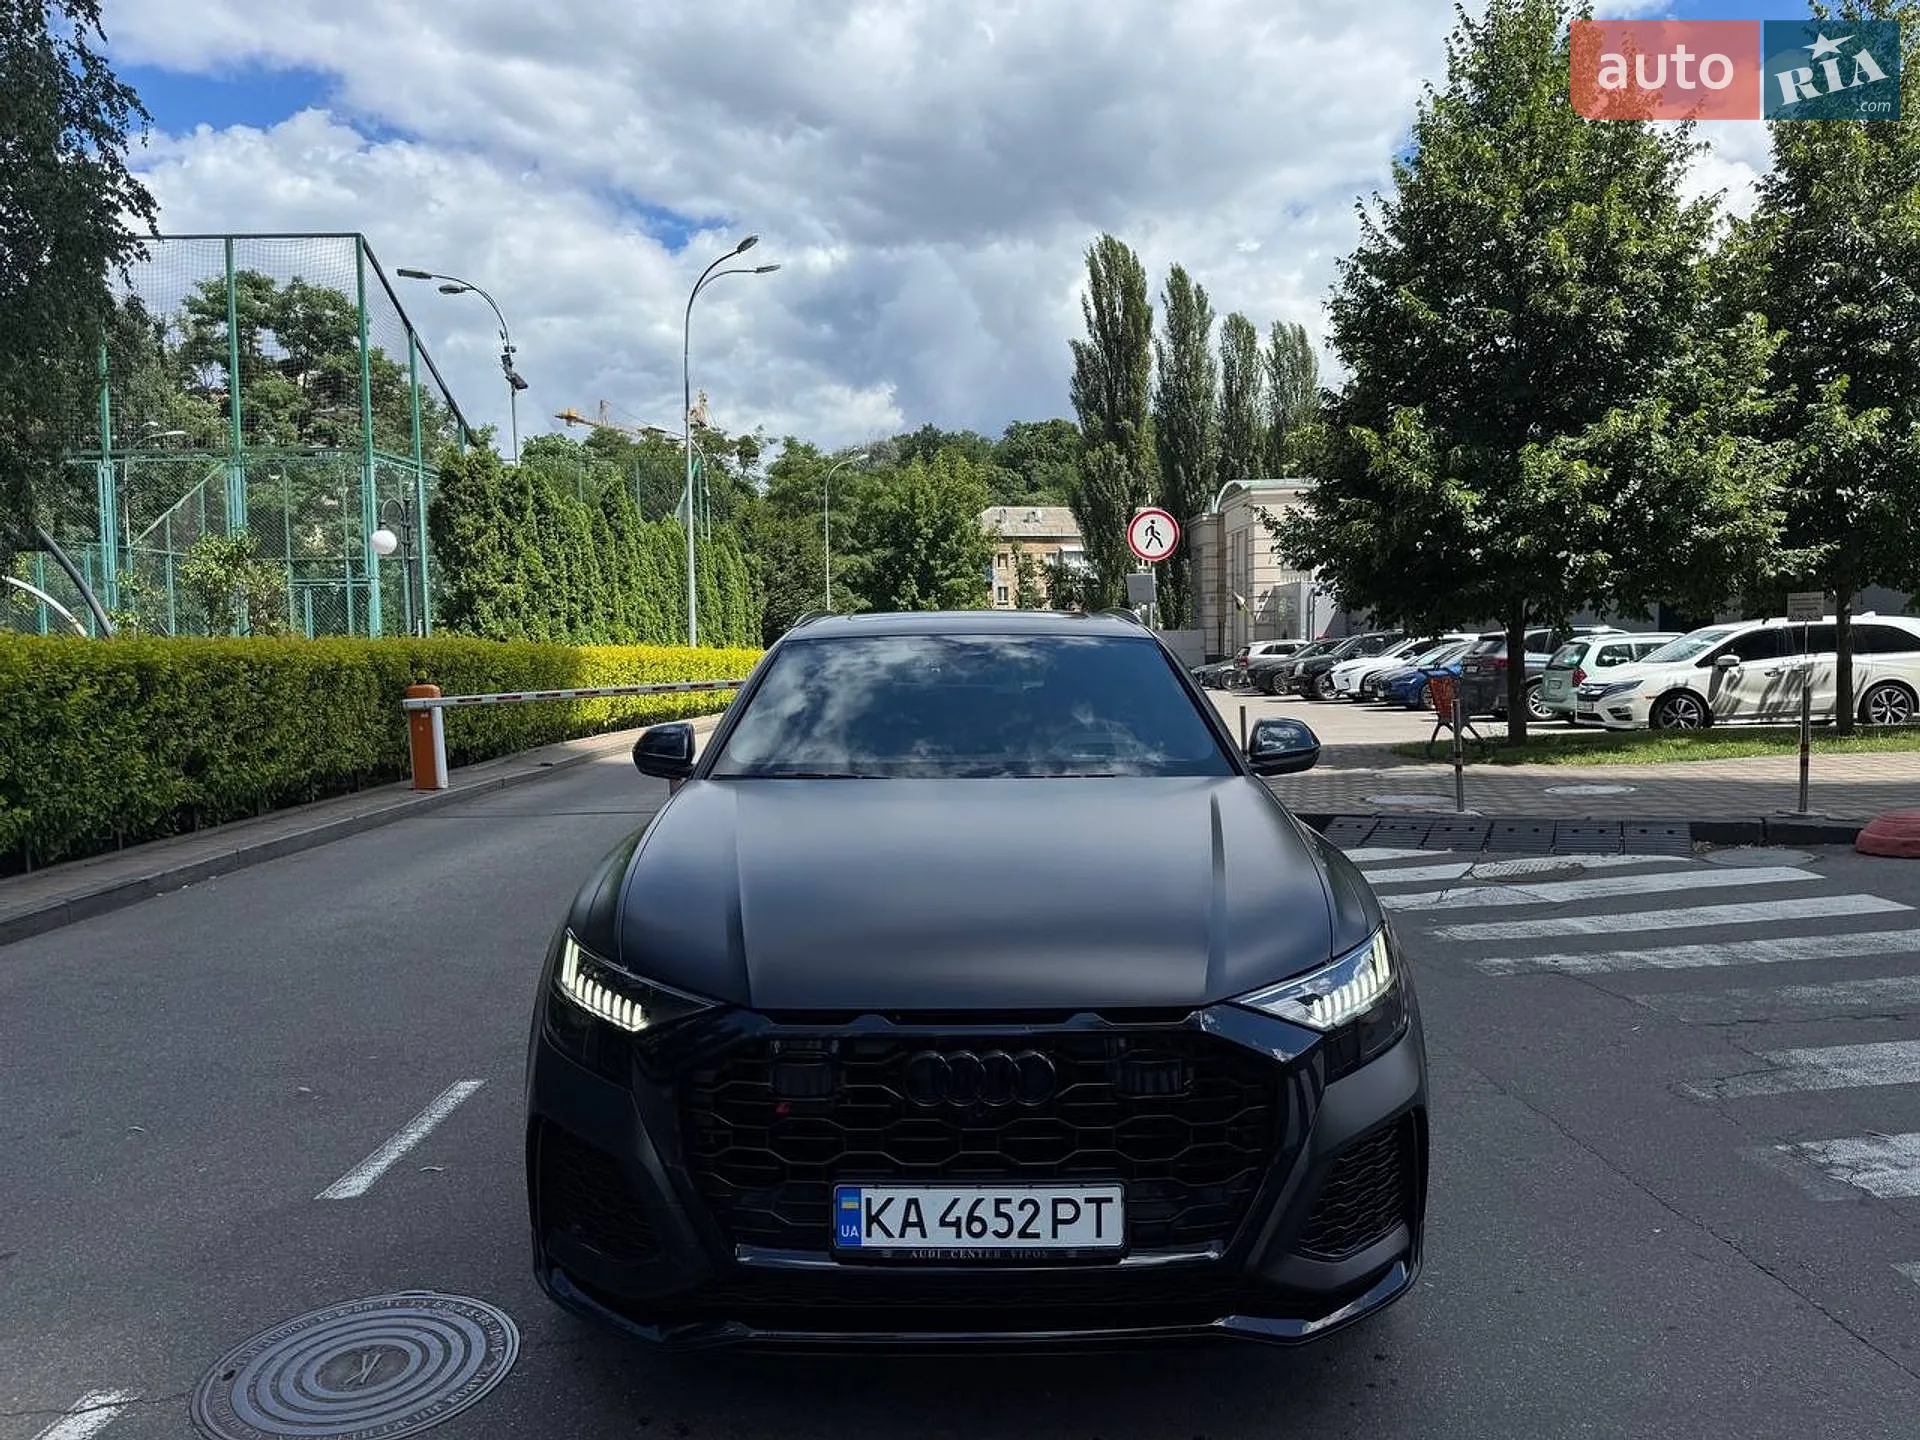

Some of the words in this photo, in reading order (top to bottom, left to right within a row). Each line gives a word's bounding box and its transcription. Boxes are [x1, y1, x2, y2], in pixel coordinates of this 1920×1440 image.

[841, 1225, 859, 1238] UA
[864, 1197, 928, 1239] KA
[938, 1197, 1041, 1239] 4652
[1051, 1197, 1114, 1239] PT
